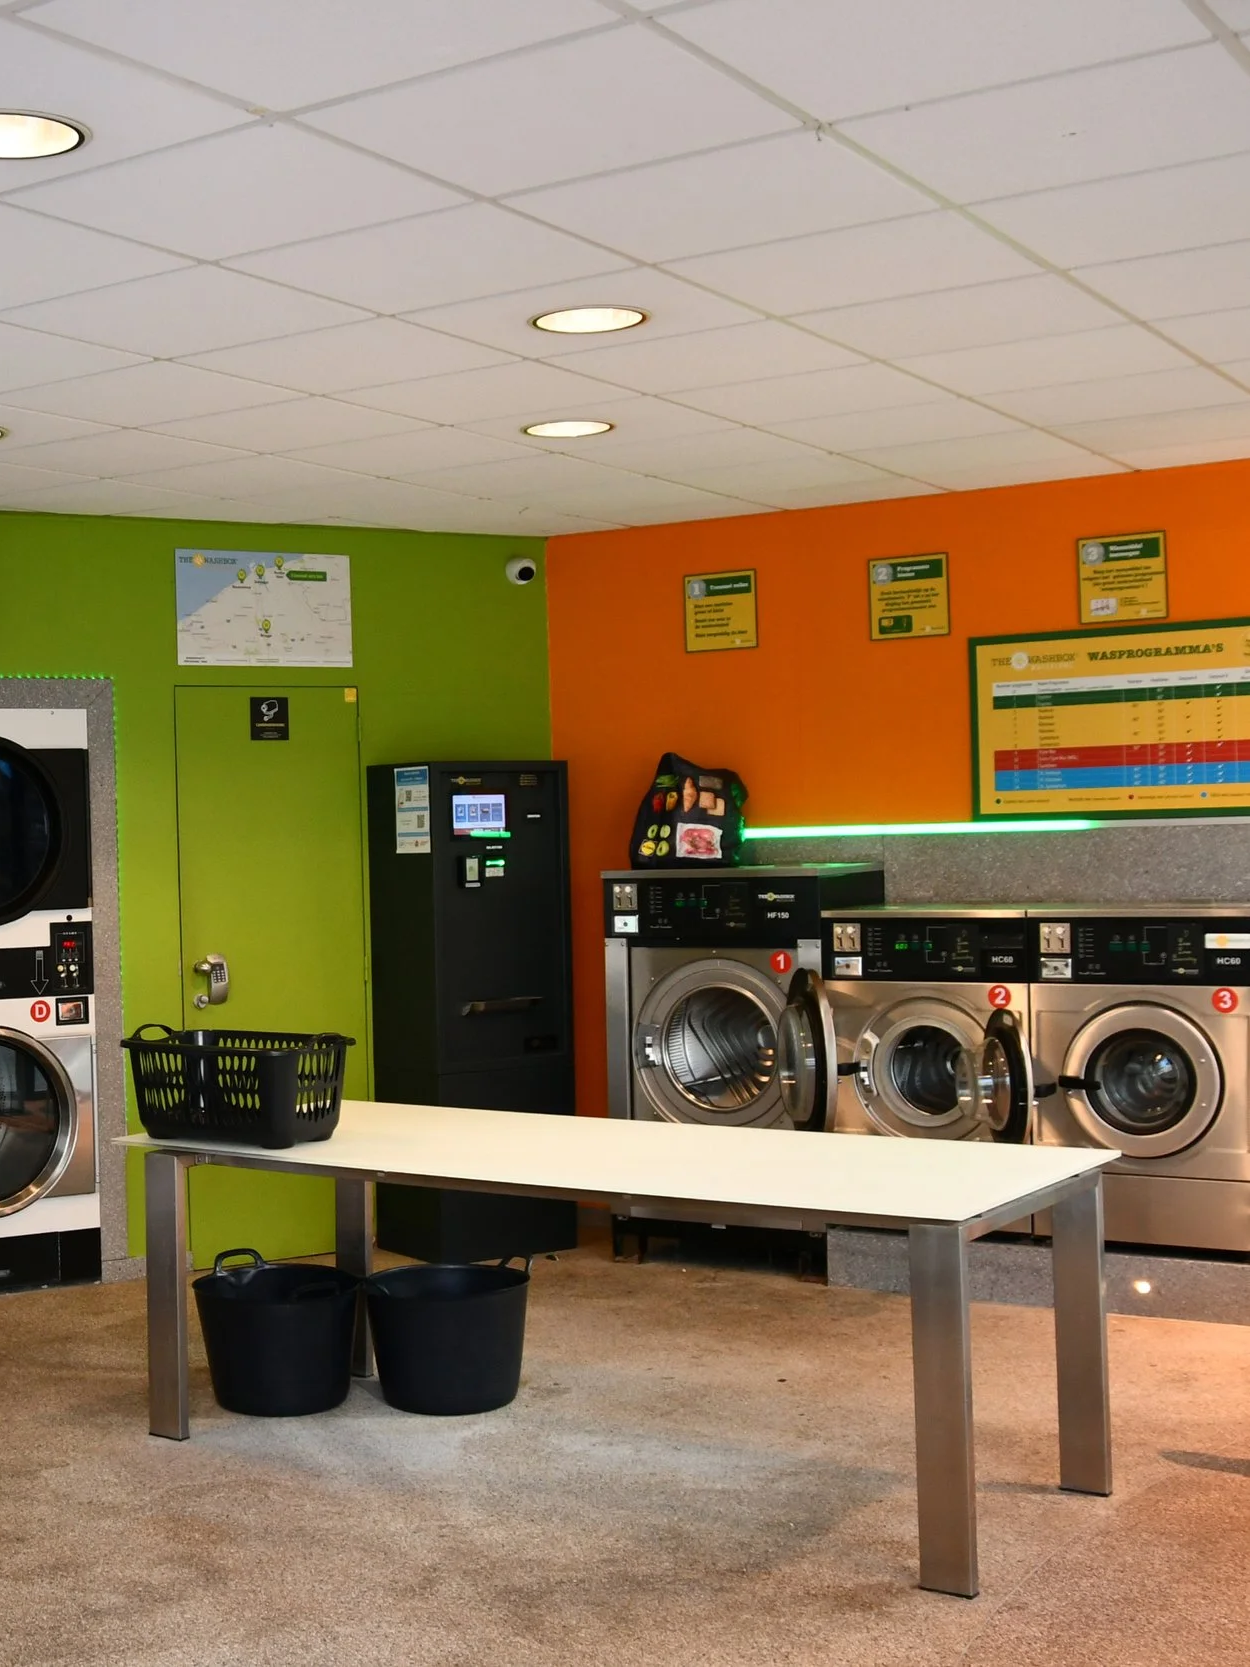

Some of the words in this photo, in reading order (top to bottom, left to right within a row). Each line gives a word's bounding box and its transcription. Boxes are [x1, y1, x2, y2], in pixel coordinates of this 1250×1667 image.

[1086, 547, 1099, 560] 3
[877, 567, 888, 580] 2
[693, 583, 700, 595] 1
[1087, 643, 1224, 661] WASPROGRAMMA'S
[991, 657, 1012, 667] THE
[767, 911, 790, 919] HF150
[776, 953, 785, 970] 1
[1216, 957, 1241, 965] HC60
[994, 987, 1007, 1005] 2
[1218, 990, 1232, 1009] 3
[34, 1003, 47, 1018] D
